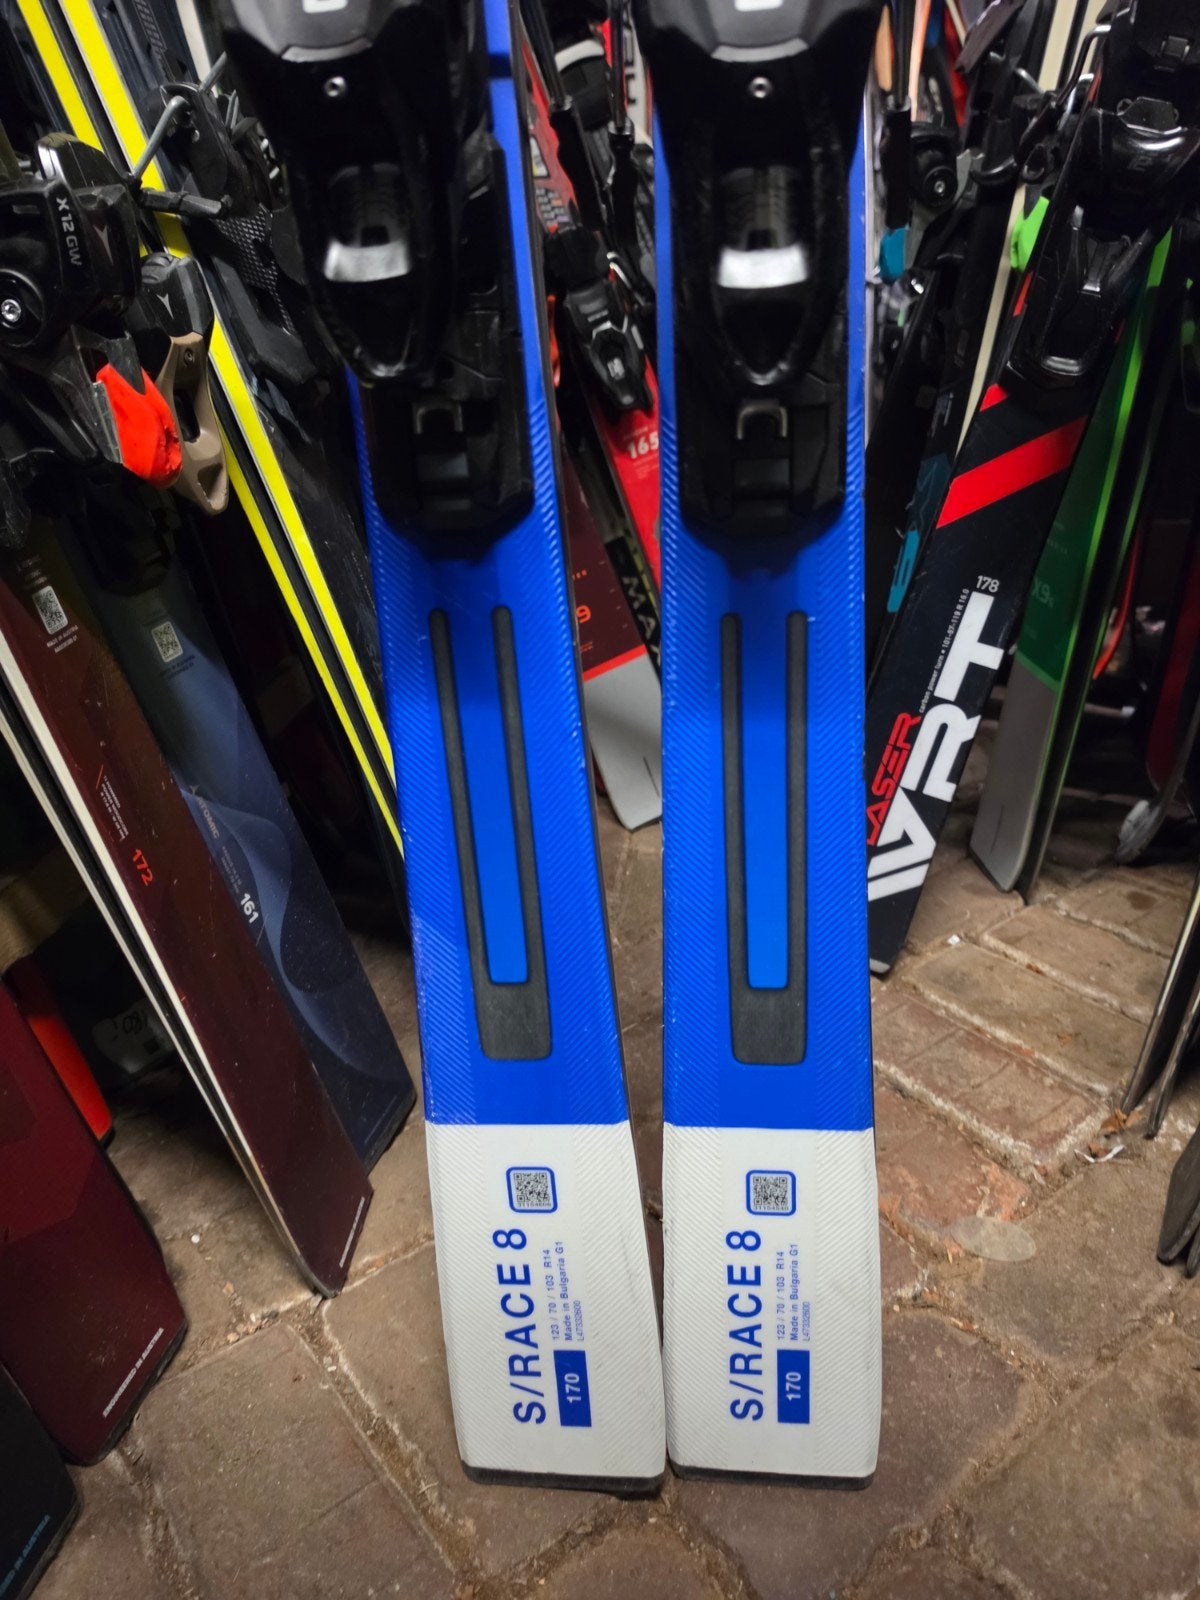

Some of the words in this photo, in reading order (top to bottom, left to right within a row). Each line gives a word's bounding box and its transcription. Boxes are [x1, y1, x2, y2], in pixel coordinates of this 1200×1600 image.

[56, 197, 70, 211] X
[66, 235, 82, 266] GW
[627, 432, 658, 459] 165
[974, 575, 1000, 593] 178
[133, 849, 152, 886] 172
[241, 893, 258, 923] 161
[492, 1229, 527, 1250] 8
[555, 1242, 564, 1254] G1
[725, 1230, 761, 1251] 8
[543, 1250, 552, 1267] R14
[776, 1251, 784, 1269] R14
[789, 1245, 798, 1256] G1
[545, 1275, 555, 1291] 103
[556, 1258, 569, 1299] Bulgaria
[776, 1276, 785, 1292] 103
[789, 1260, 800, 1300] Bulgaria
[548, 1302, 557, 1313] 70
[562, 1303, 569, 1311] in
[776, 1303, 785, 1314] 70
[790, 1304, 798, 1312] in
[550, 1324, 559, 1340] 123
[562, 1314, 572, 1341] Made
[776, 1324, 785, 1340] 123
[790, 1316, 799, 1341] Made
[496, 1264, 546, 1424] S/RACE
[727, 1265, 763, 1421] S/RACE
[564, 1373, 581, 1403] 170
[785, 1372, 801, 1401] 170
